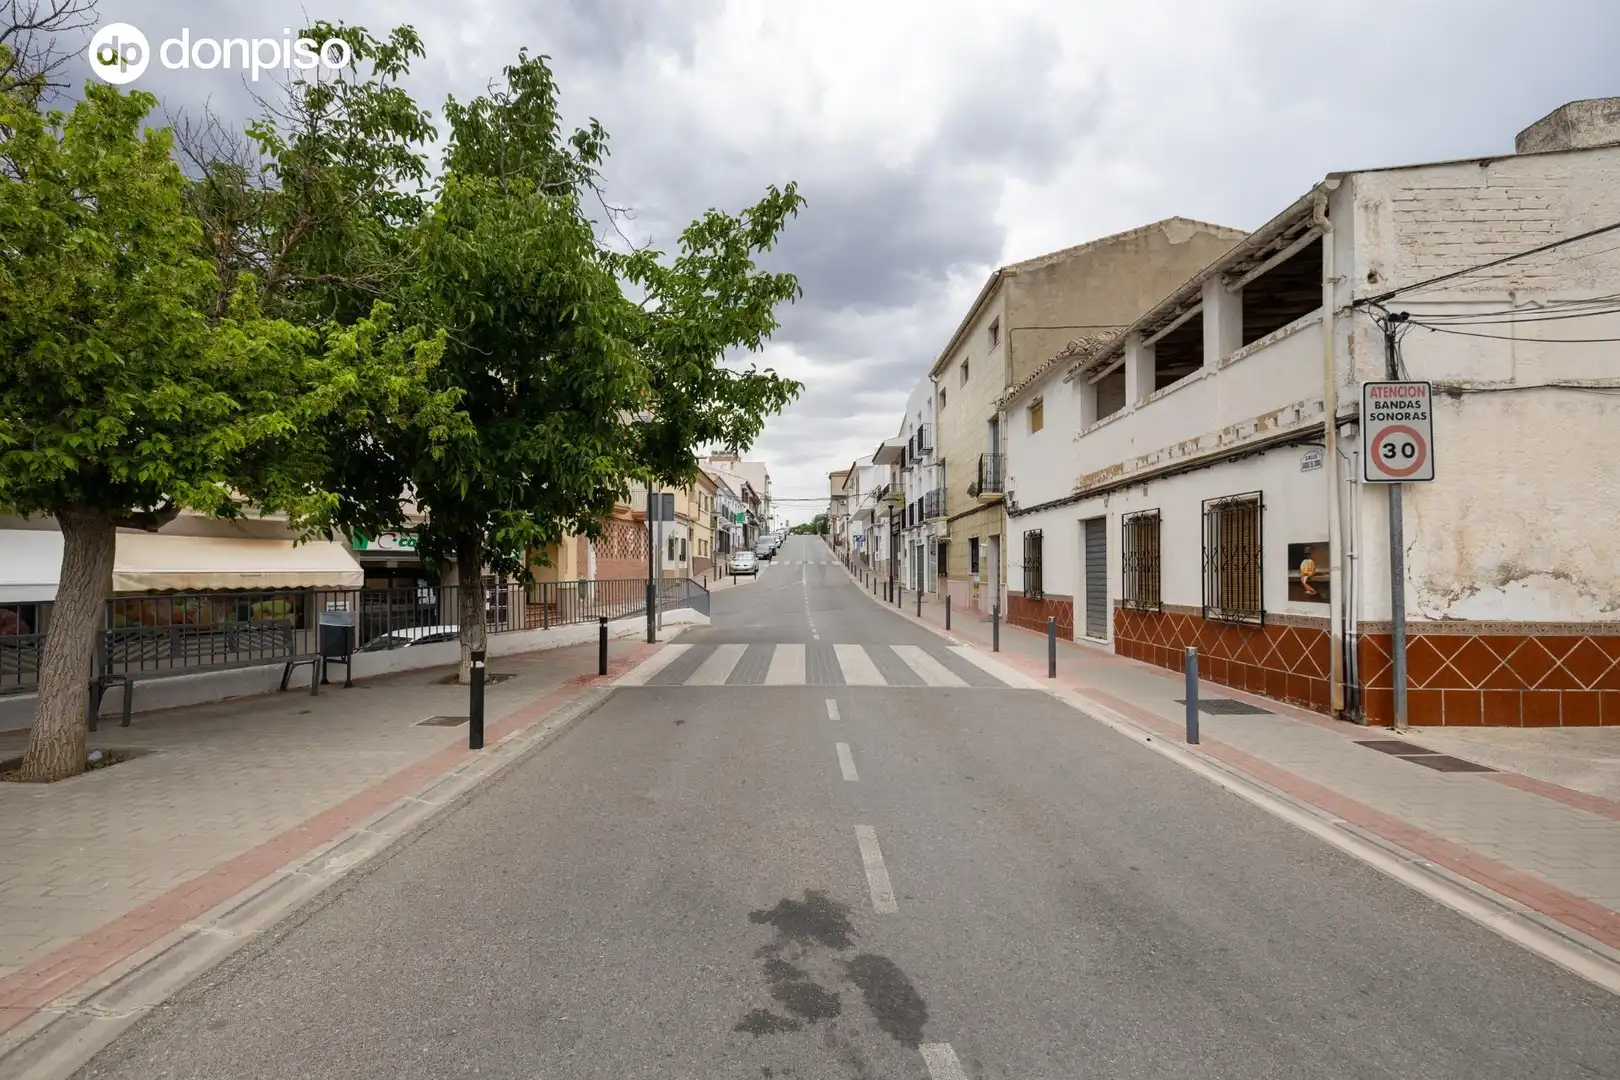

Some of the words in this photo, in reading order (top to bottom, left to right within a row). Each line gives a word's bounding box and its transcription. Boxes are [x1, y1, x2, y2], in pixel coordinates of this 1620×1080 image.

[1370, 386, 1426, 399] ATENCION
[1374, 400, 1422, 410] BANDAS
[1369, 412, 1427, 421] SONORAS
[1382, 442, 1416, 459] 30
